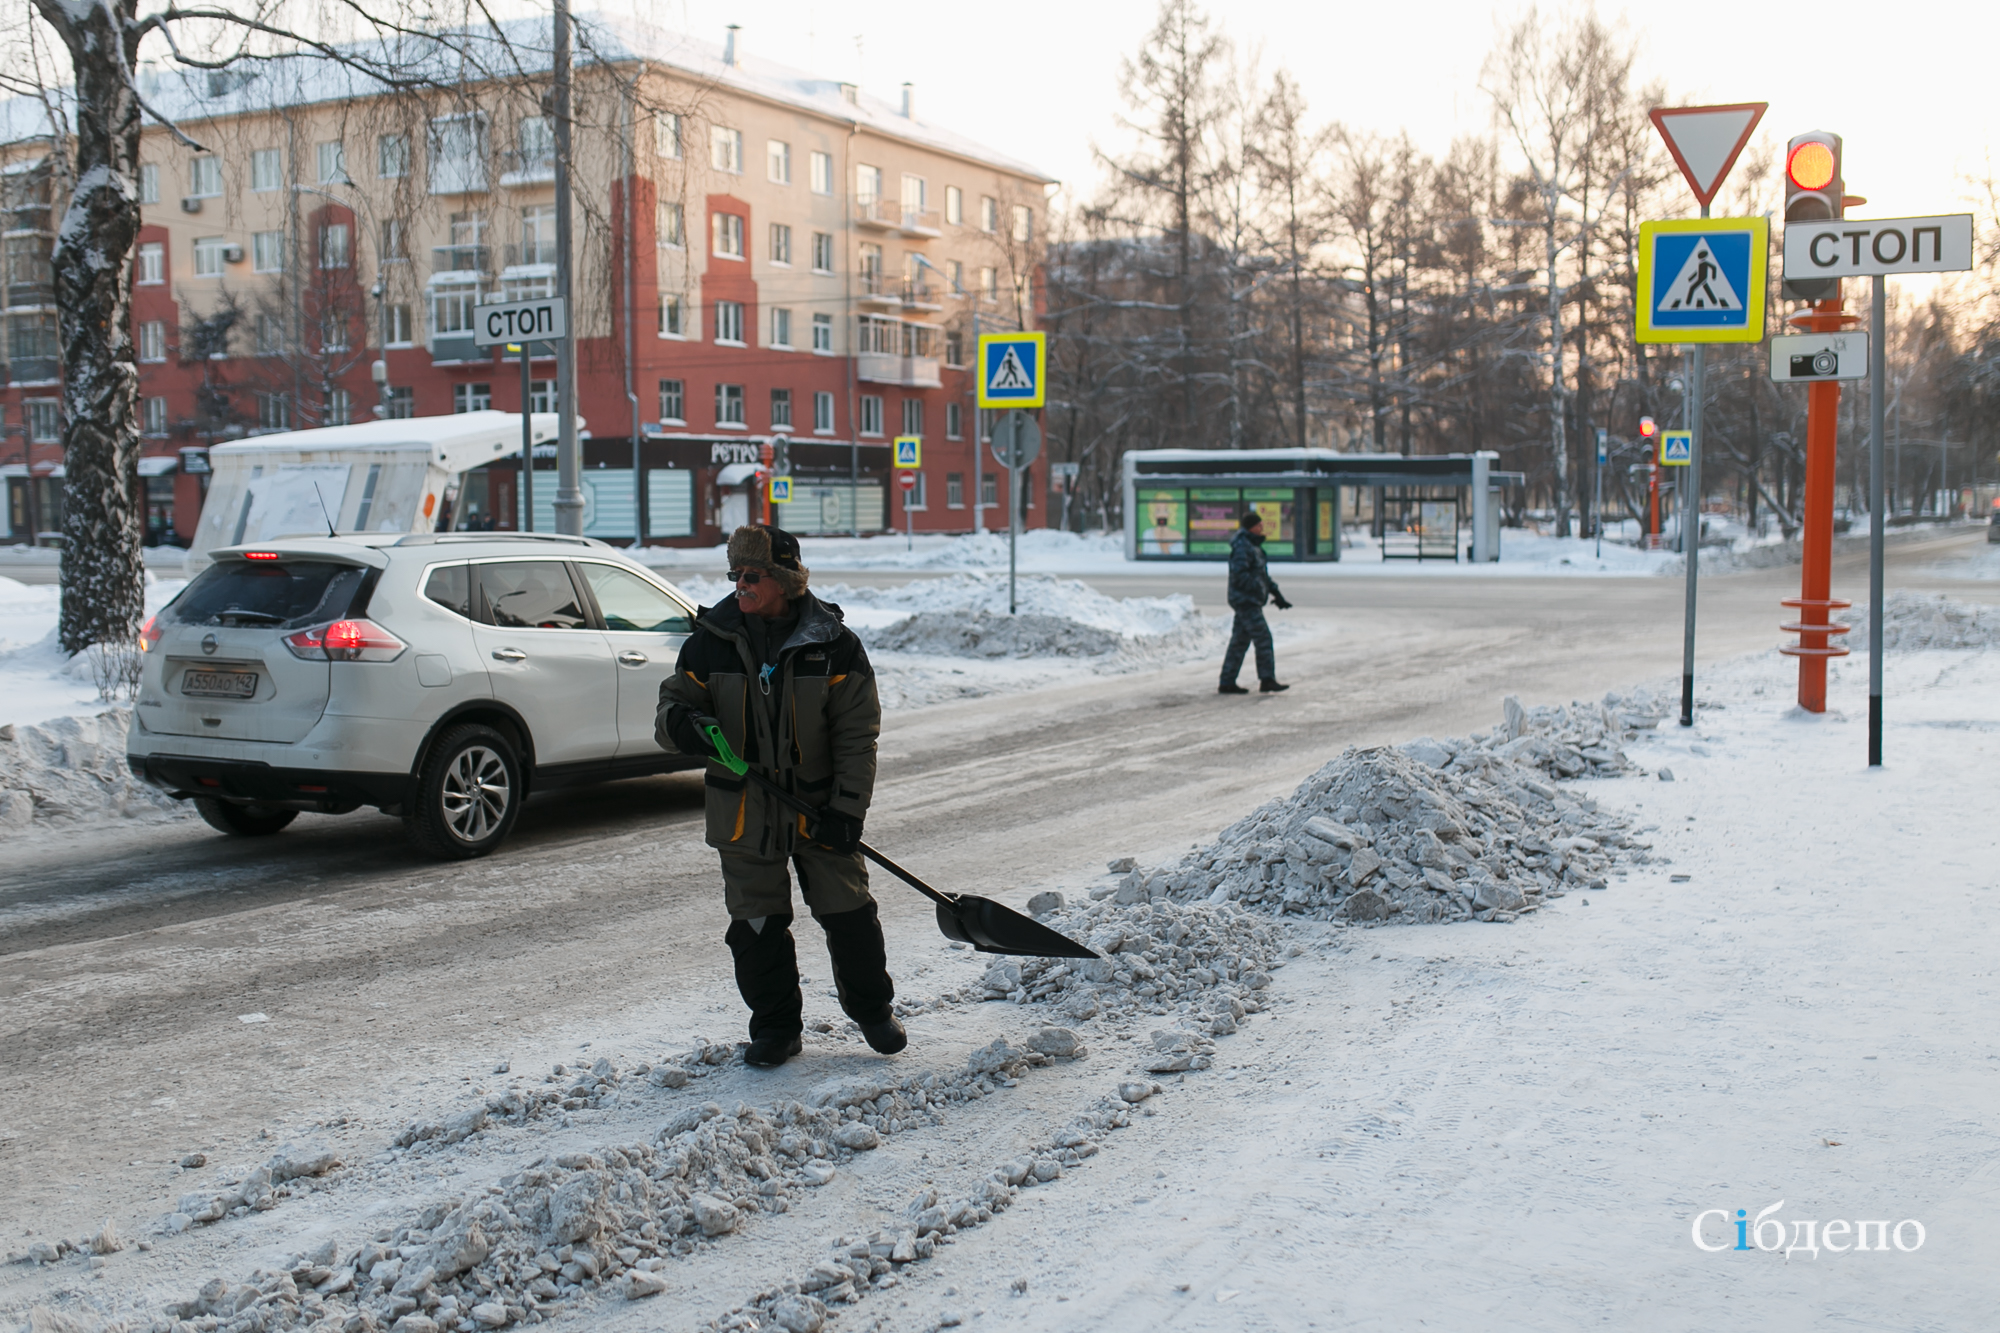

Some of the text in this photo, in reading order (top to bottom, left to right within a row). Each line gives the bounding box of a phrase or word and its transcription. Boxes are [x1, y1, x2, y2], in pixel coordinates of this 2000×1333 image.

[1809, 226, 1942, 268] СТОП
[487, 306, 553, 338] СТОП
[711, 442, 759, 463] РЕТРО
[235, 674, 253, 689] 142
